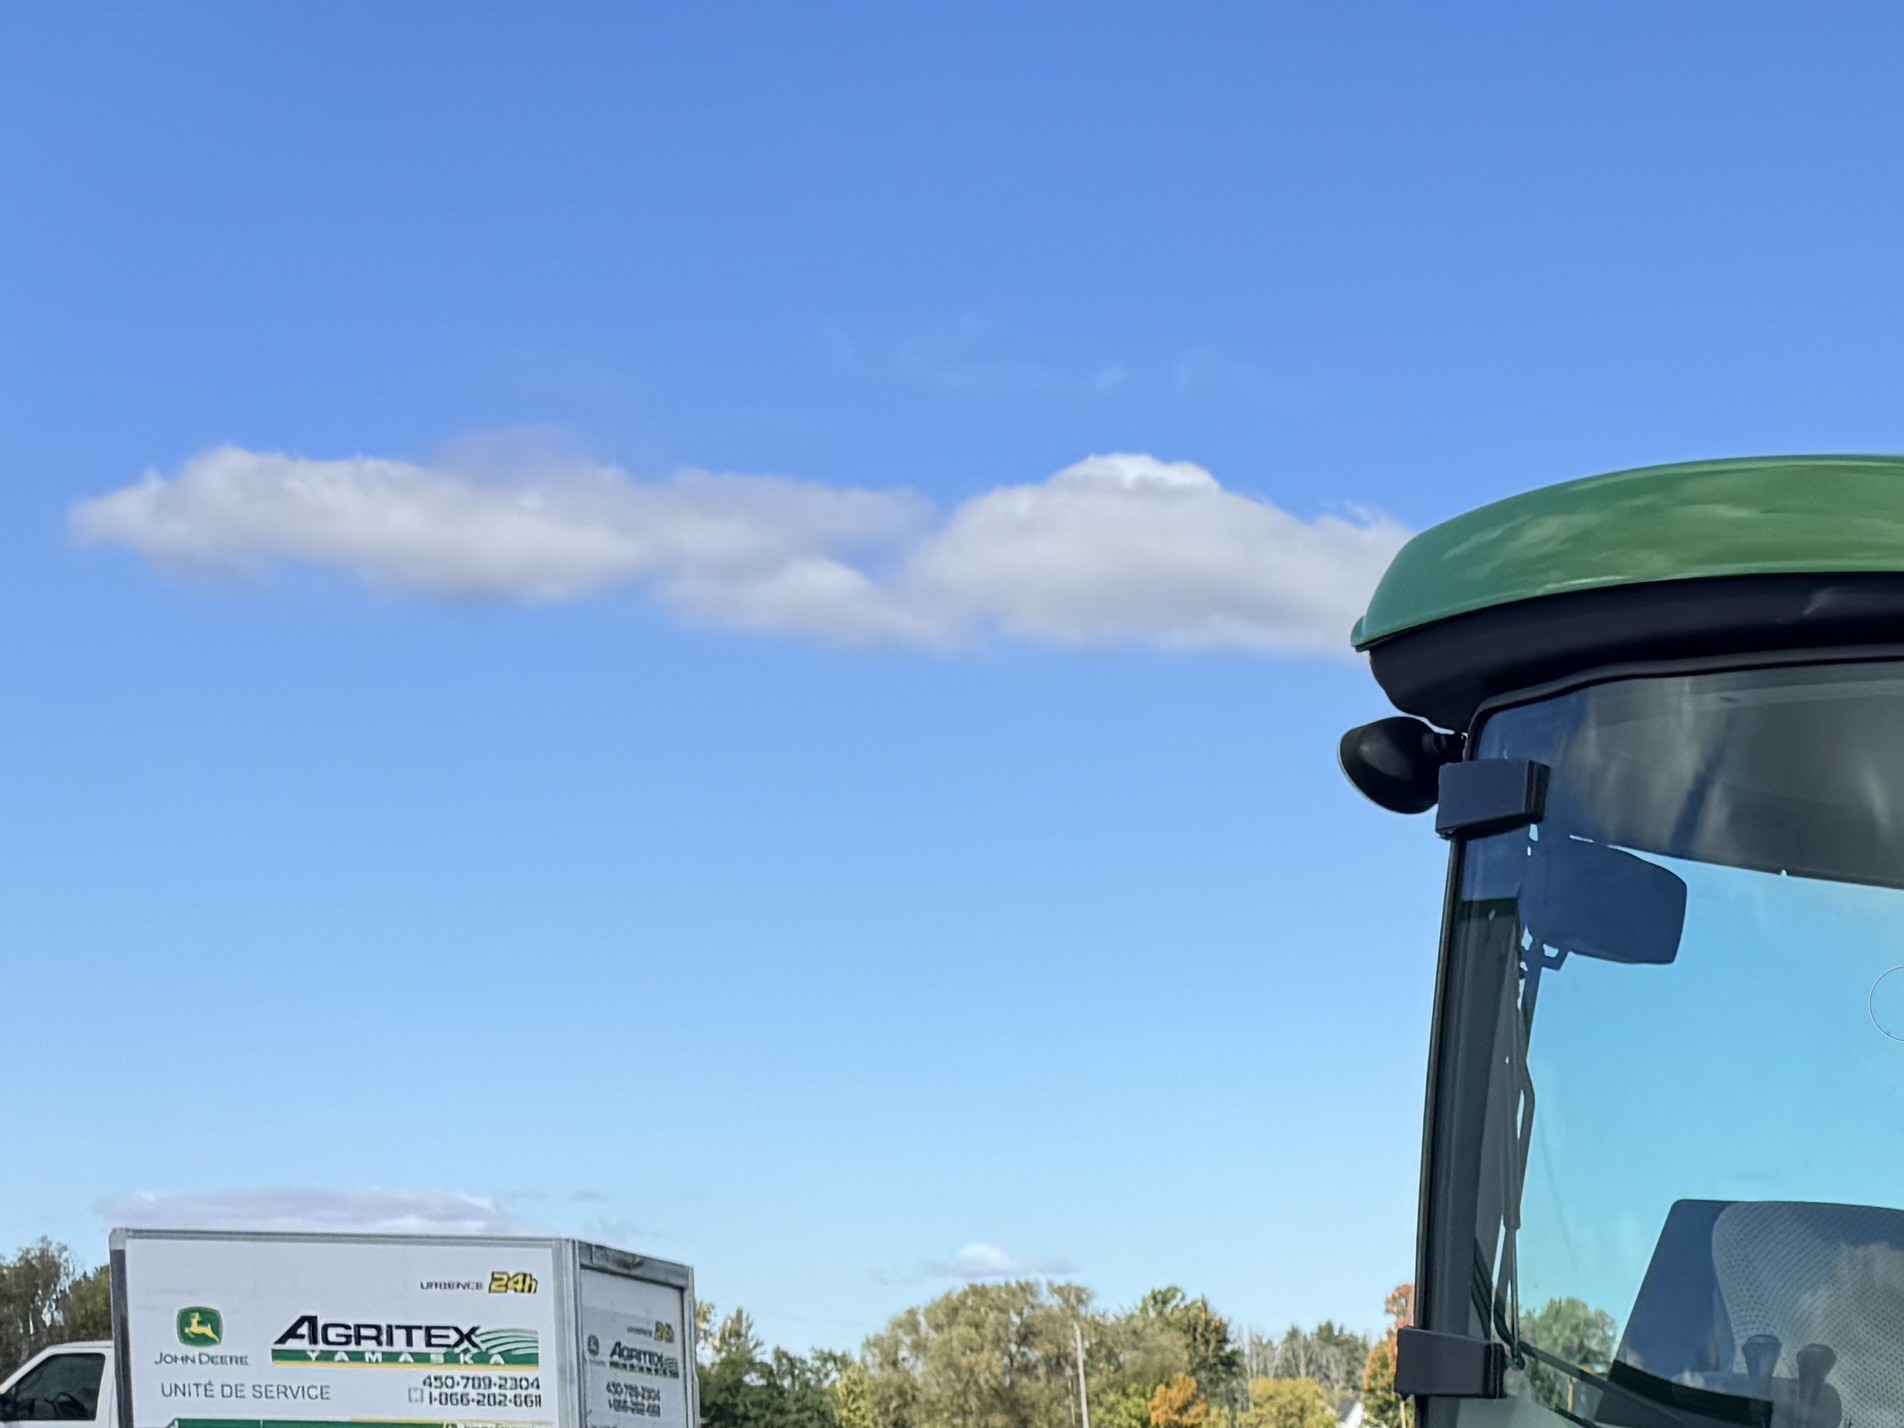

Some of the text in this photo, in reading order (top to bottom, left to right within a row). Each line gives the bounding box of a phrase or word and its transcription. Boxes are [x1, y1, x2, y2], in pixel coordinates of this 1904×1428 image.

[488, 1271, 538, 1293] 24h
[273, 1315, 482, 1350] AGRITEX
[154, 1352, 249, 1366] JOHN DEERE
[307, 1351, 505, 1365] YAMASKA
[161, 1380, 331, 1400] UNITÉ DE SERVICE
